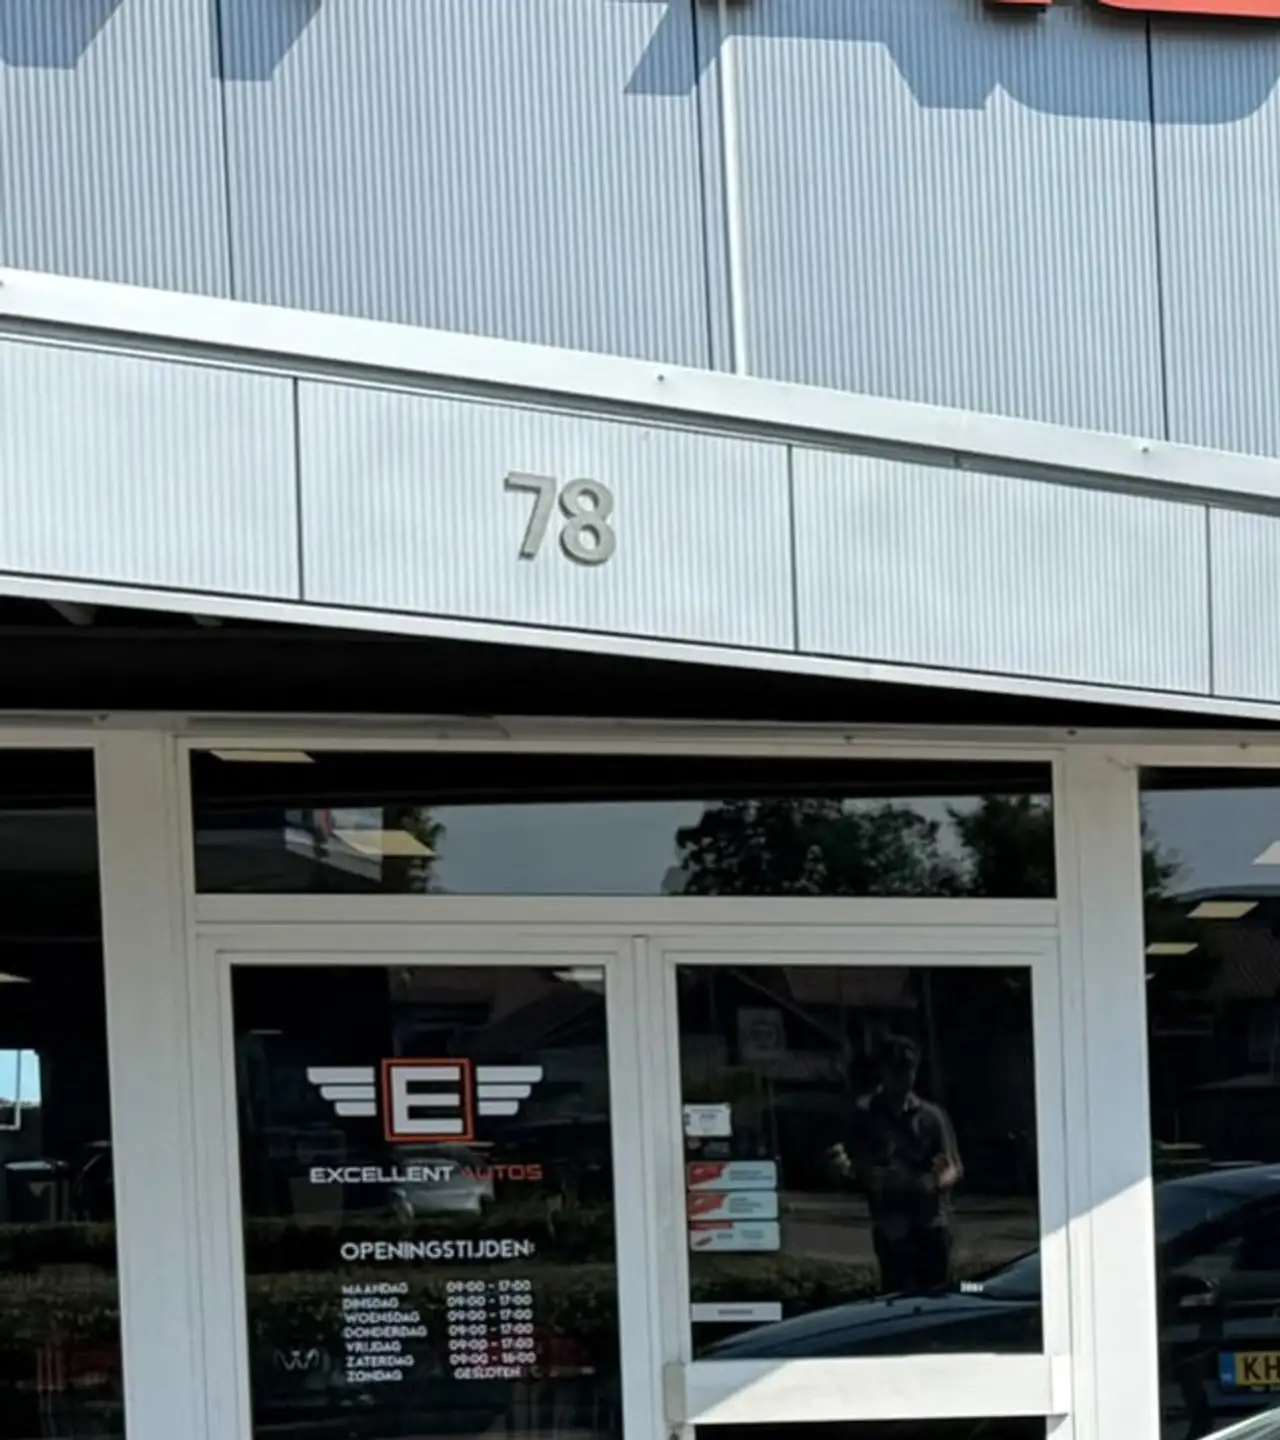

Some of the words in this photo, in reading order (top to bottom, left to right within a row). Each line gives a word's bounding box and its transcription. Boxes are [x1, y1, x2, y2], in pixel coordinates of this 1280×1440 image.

[503, 471, 617, 567] 78
[390, 1066, 464, 1134] E
[310, 1165, 454, 1184] EXCELLENT
[461, 1163, 544, 1181] AUTOS
[340, 1239, 535, 1261] OPENINGSTIJDEN:
[342, 1282, 409, 1294] MAANDAG
[343, 1325, 428, 1338] DONDERDAG
[345, 1340, 402, 1352] VRIJDAG
[346, 1354, 415, 1367] ZATERDAG
[346, 1369, 403, 1382] ZONDAG
